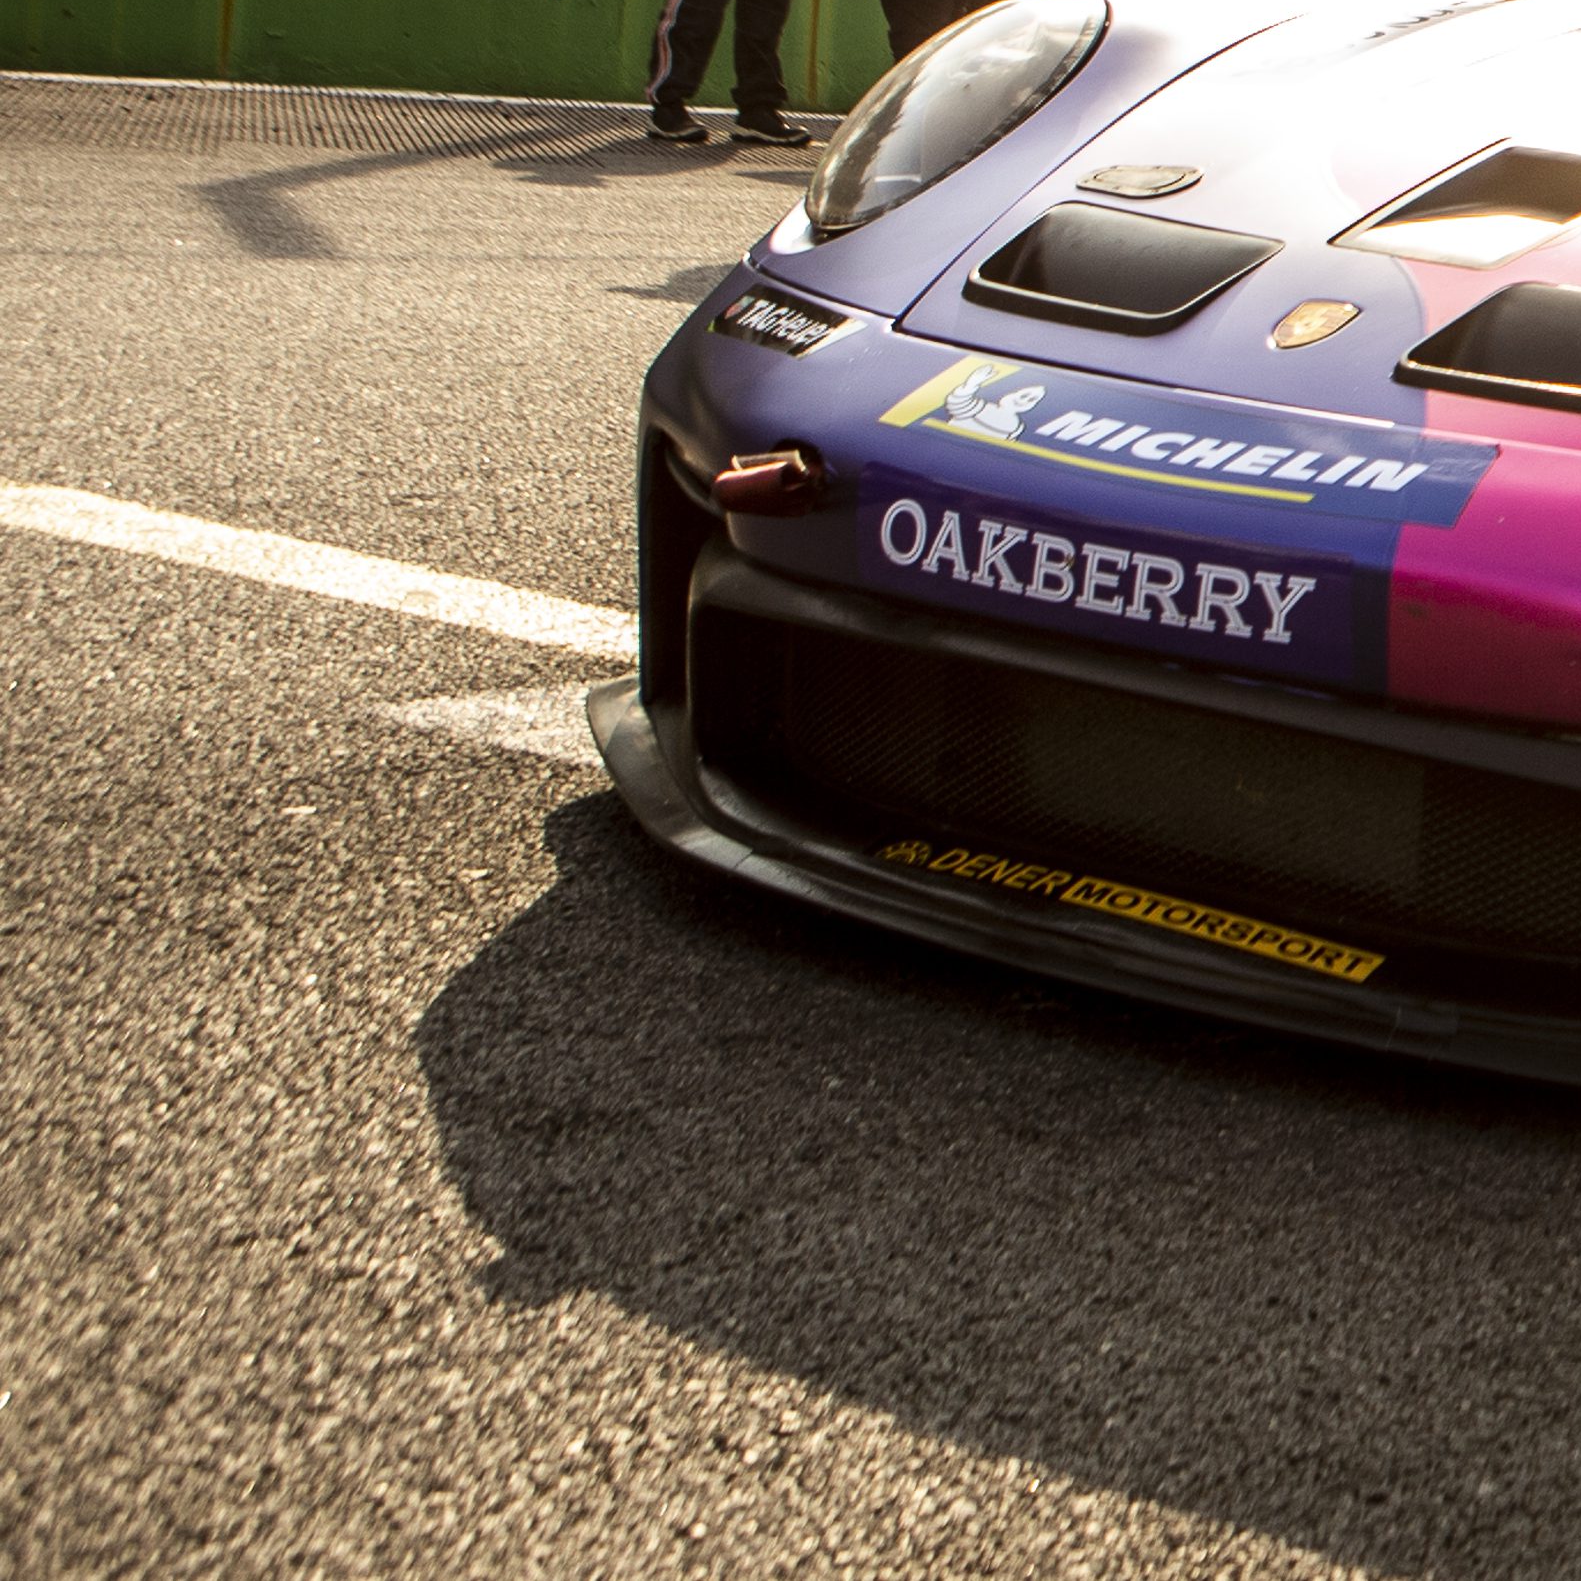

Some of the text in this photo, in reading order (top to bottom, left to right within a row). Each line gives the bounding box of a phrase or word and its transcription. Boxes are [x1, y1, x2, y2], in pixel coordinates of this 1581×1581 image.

[1034, 410, 1428, 493] MICHELIN
[880, 498, 1317, 644] OAKBERRY
[927, 847, 1376, 976] DENER MOTORSPORT
